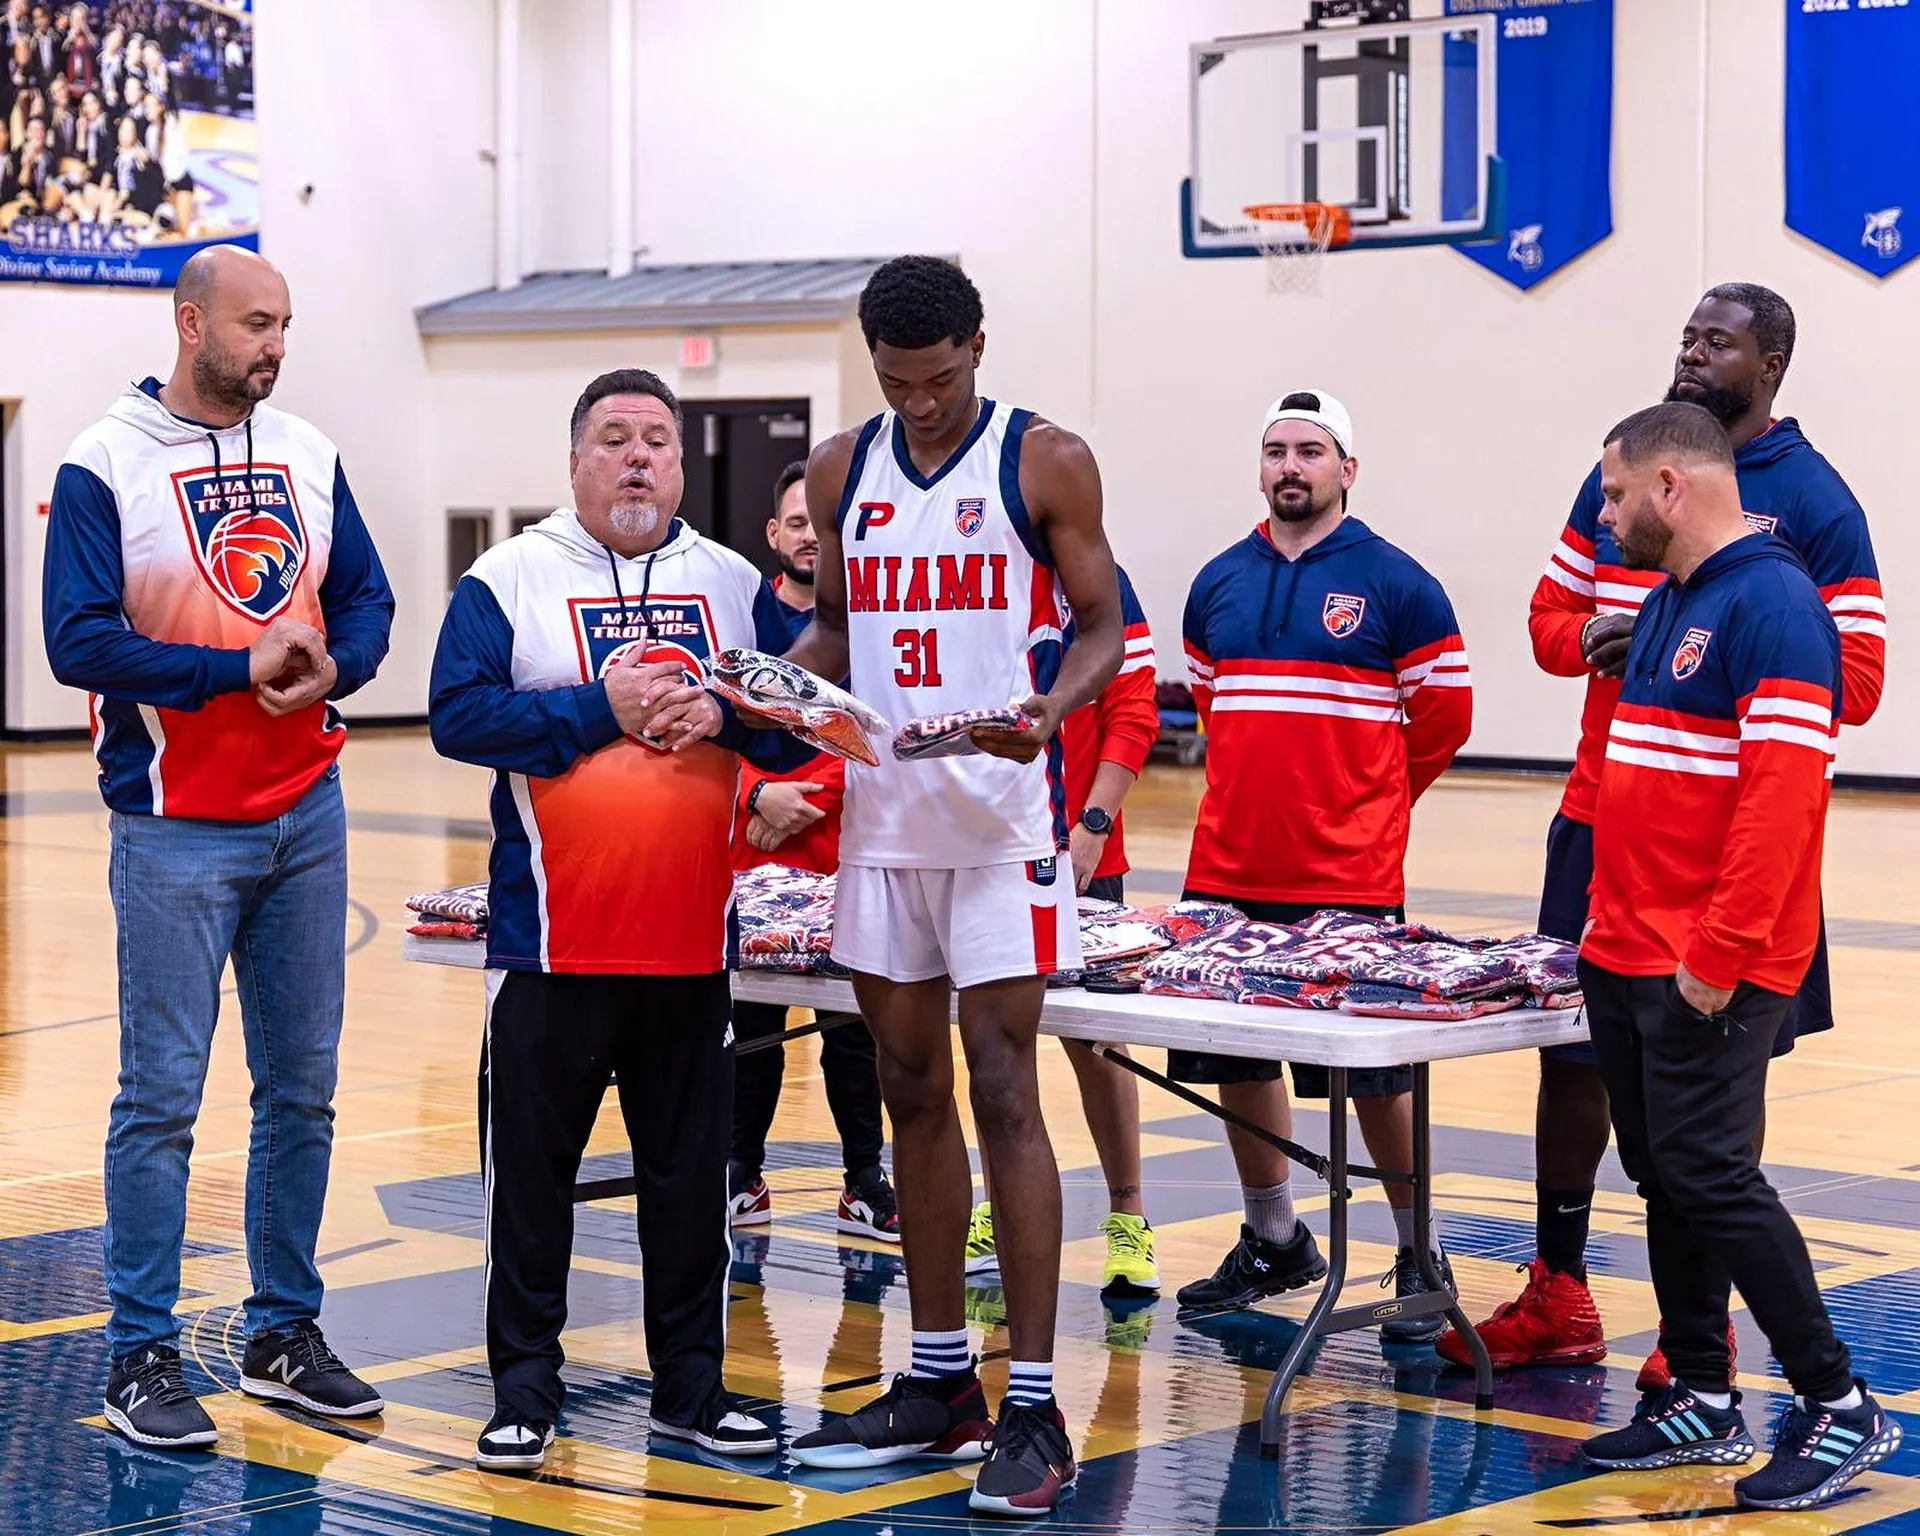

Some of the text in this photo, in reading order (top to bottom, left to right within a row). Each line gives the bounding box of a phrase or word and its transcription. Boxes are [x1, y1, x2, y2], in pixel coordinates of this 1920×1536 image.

[1503, 16, 1548, 38] 2019
[9, 217, 140, 259] SHARKS
[45, 256, 93, 279] Savior
[94, 259, 163, 286] Academy
[203, 478, 275, 498] MIAMI
[847, 553, 1009, 613] MIAMI
[601, 609, 684, 625] MIAMI
[893, 628, 943, 688] 31
